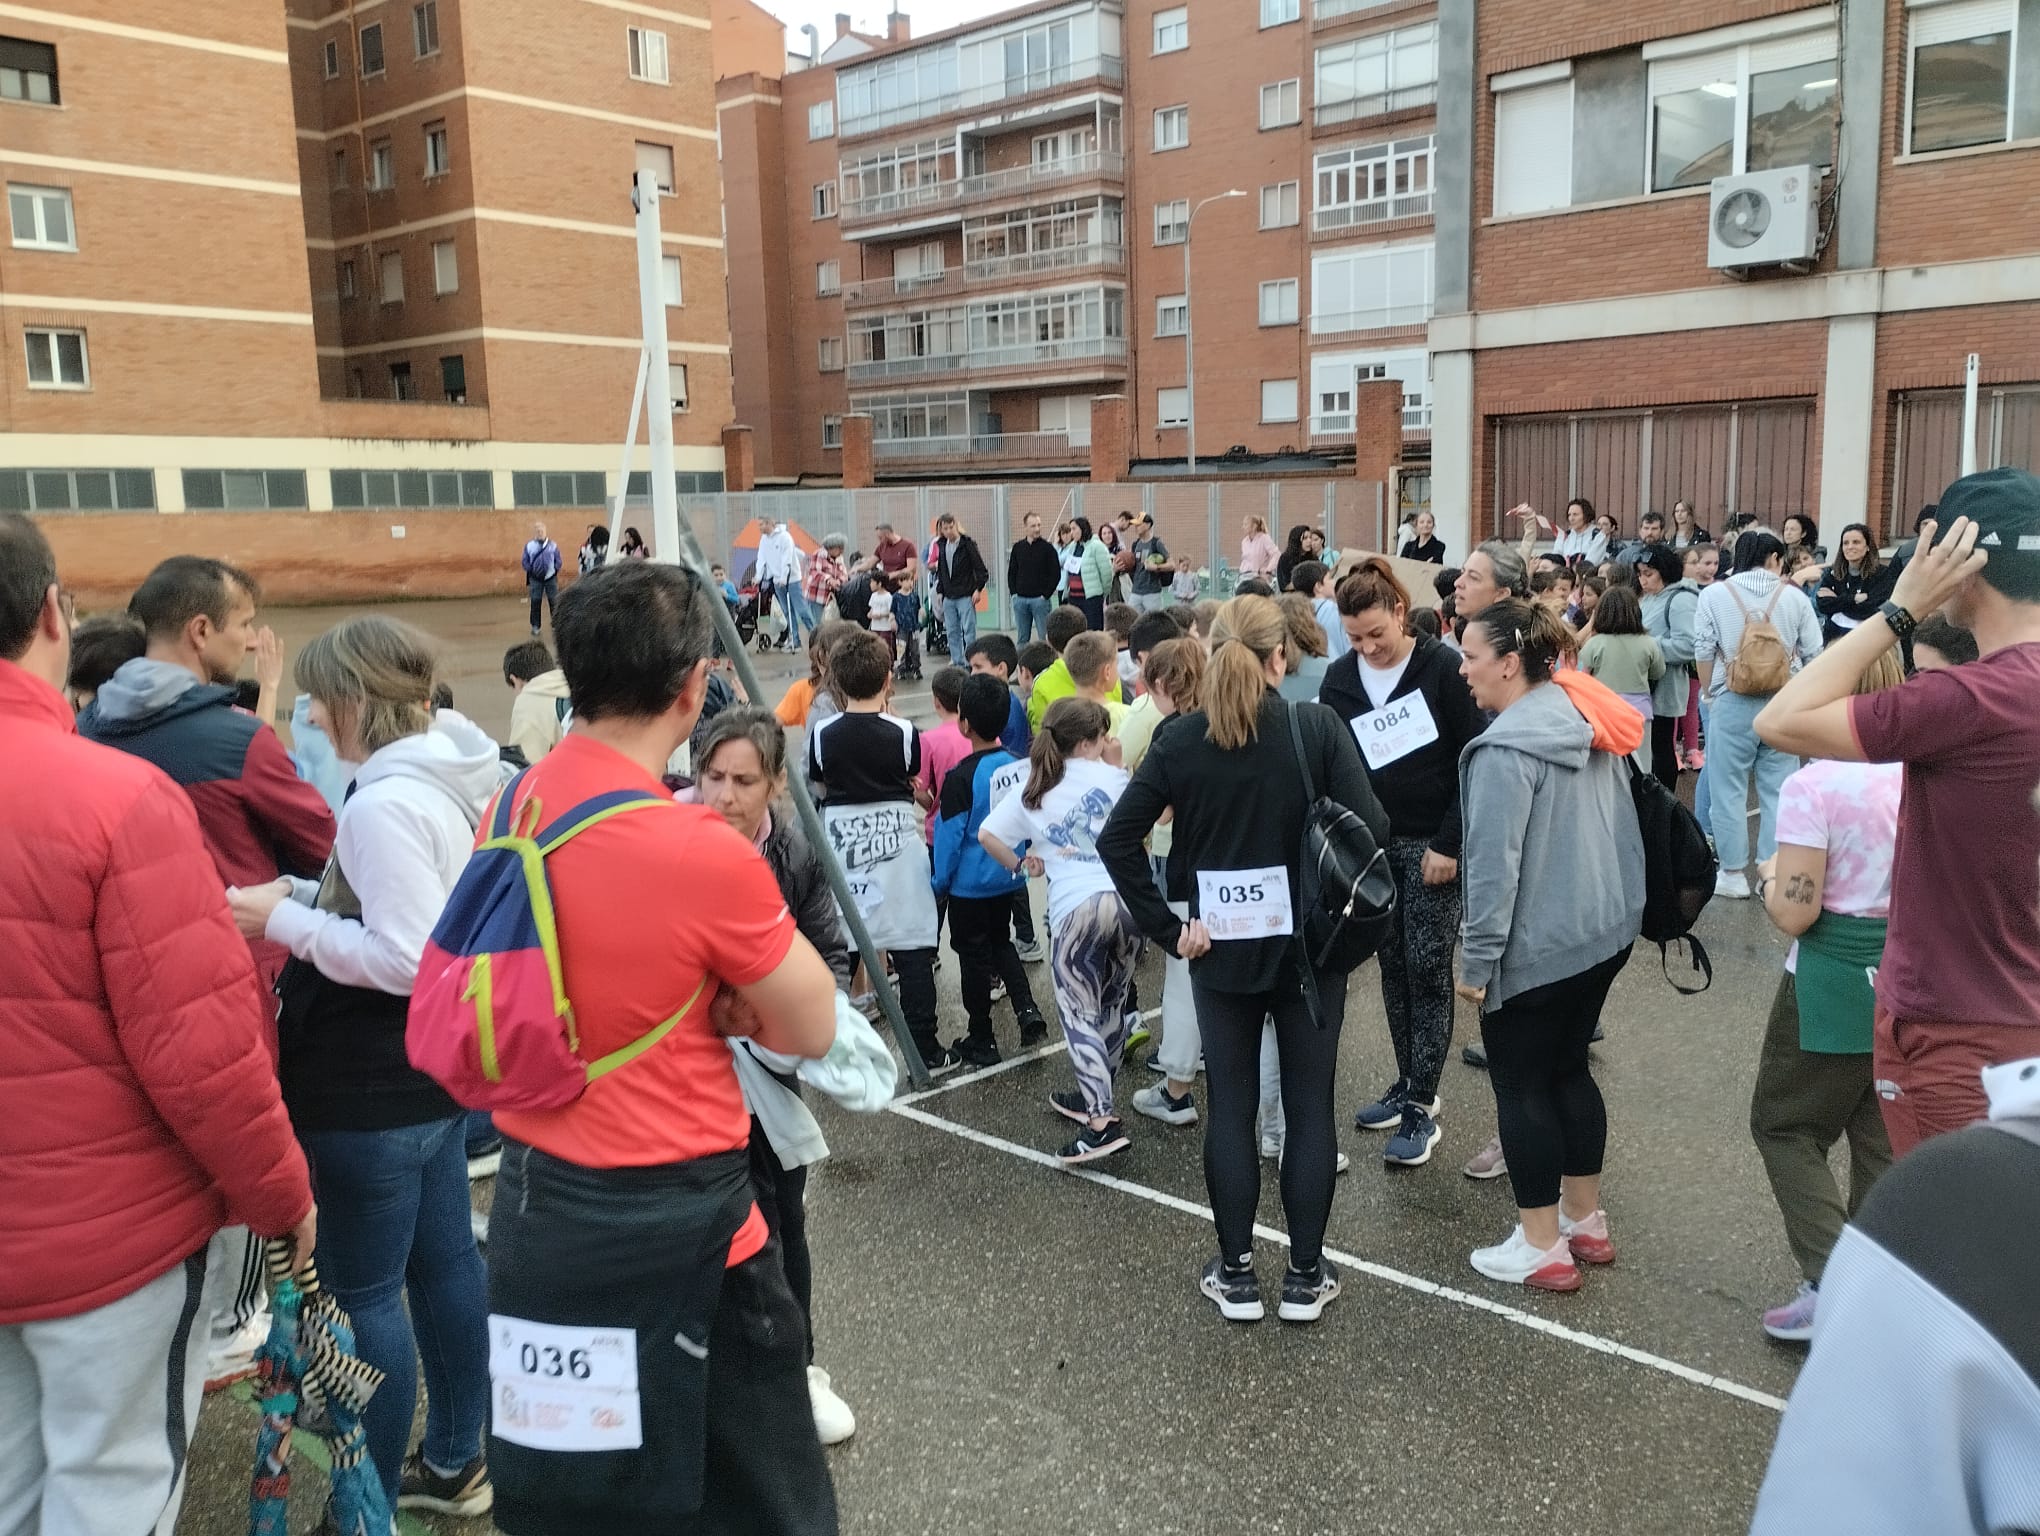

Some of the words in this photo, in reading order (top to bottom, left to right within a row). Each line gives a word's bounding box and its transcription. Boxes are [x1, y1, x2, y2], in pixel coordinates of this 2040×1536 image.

[1373, 706, 1411, 732] 084
[850, 883, 868, 895] 37
[1219, 884, 1264, 904] 035
[521, 1343, 591, 1379] 036
